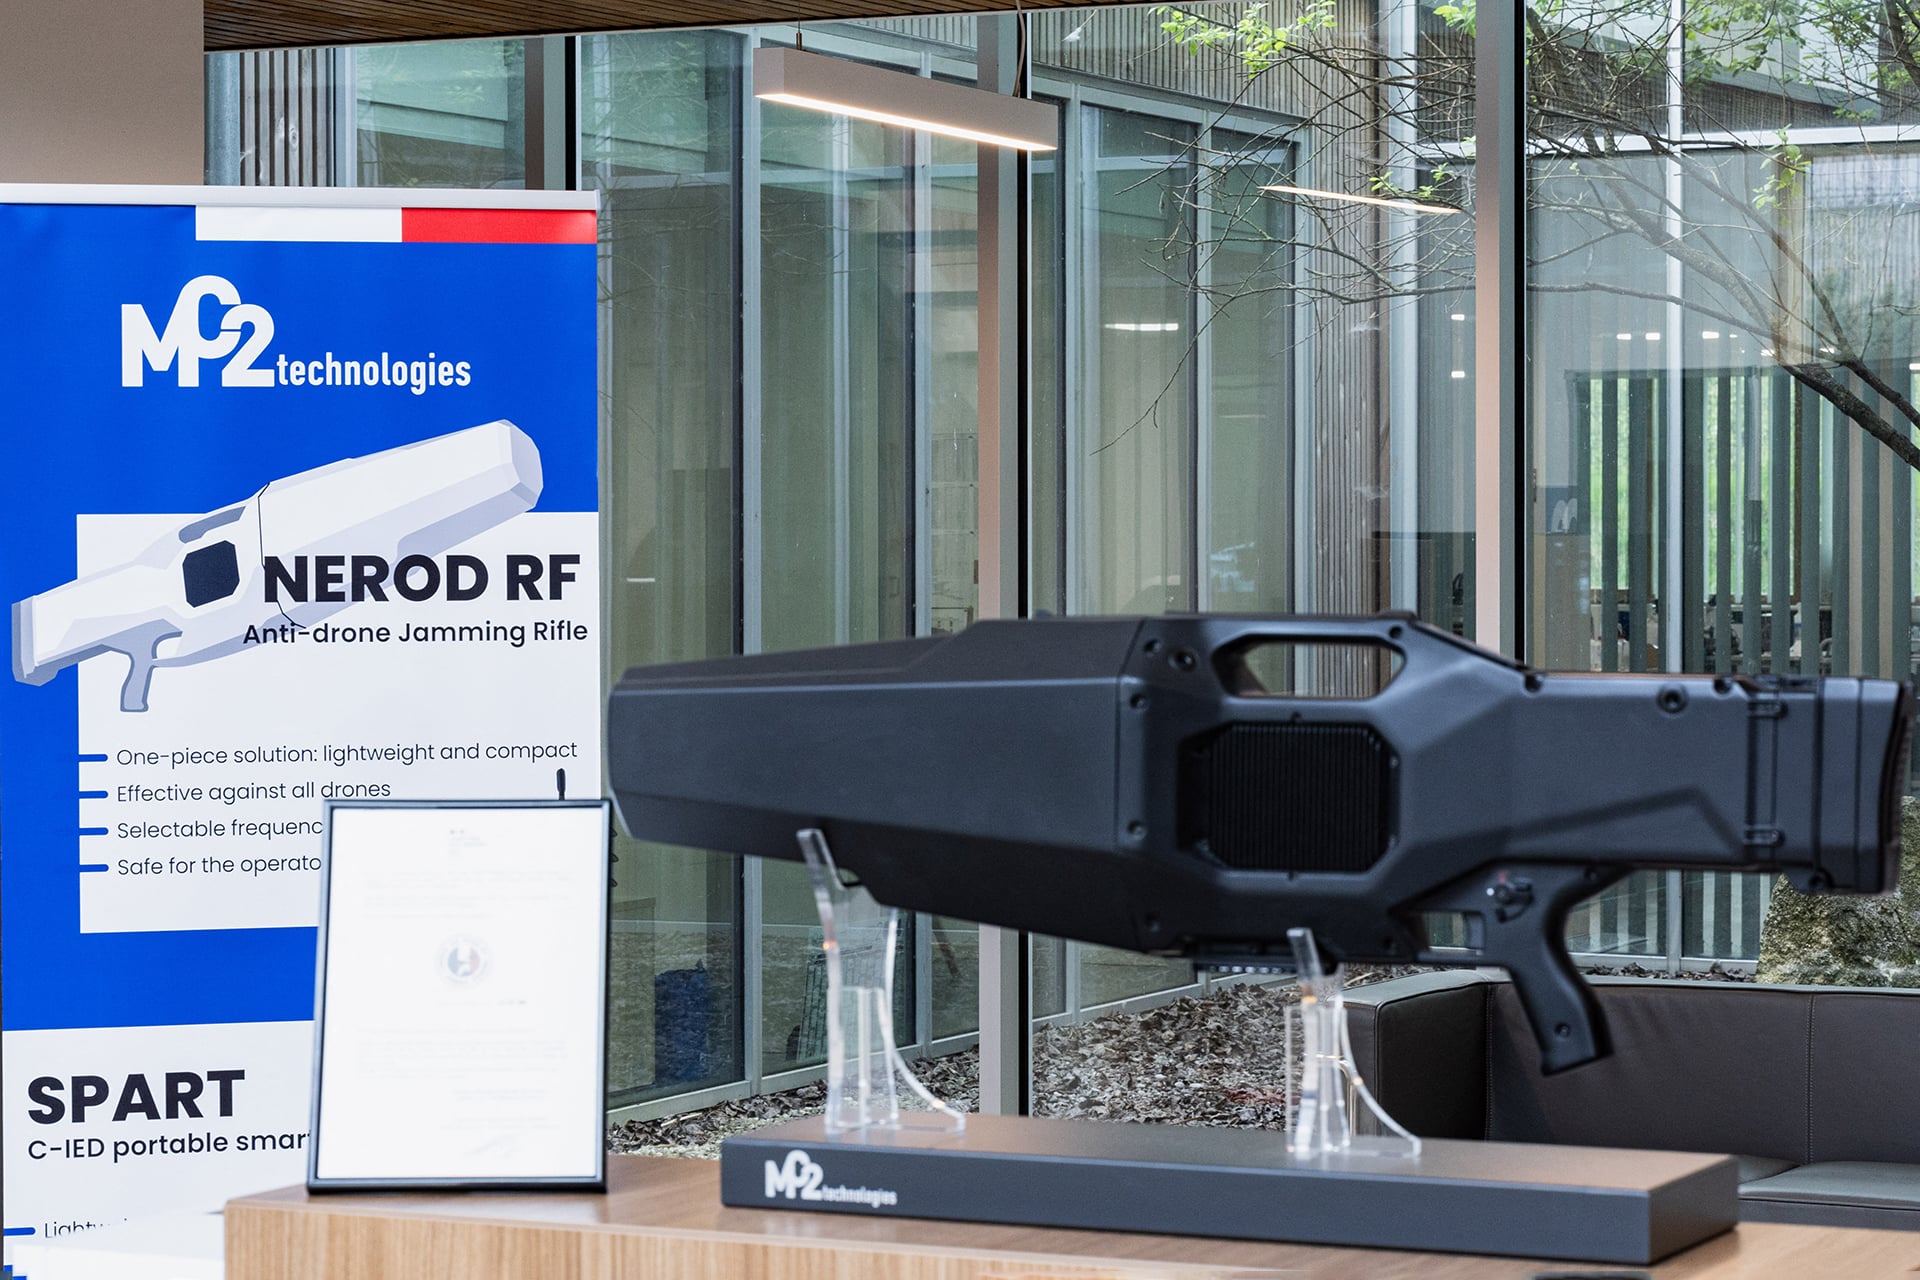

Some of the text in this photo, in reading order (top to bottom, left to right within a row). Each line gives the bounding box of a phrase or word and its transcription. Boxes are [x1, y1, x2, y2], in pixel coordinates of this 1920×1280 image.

[276, 351, 472, 396] technologies
[263, 553, 581, 604] NEROD RF
[242, 619, 589, 648] Anti-drone Jamming Rifle
[116, 742, 578, 770] One-piece solution: lightweight and compact
[117, 780, 391, 806] Effective against all drones
[117, 818, 323, 841] Selectable frequenc
[118, 855, 322, 877] Safe for the operato
[27, 1069, 245, 1125] SPART
[27, 1131, 311, 1163] C-IED portable smar
